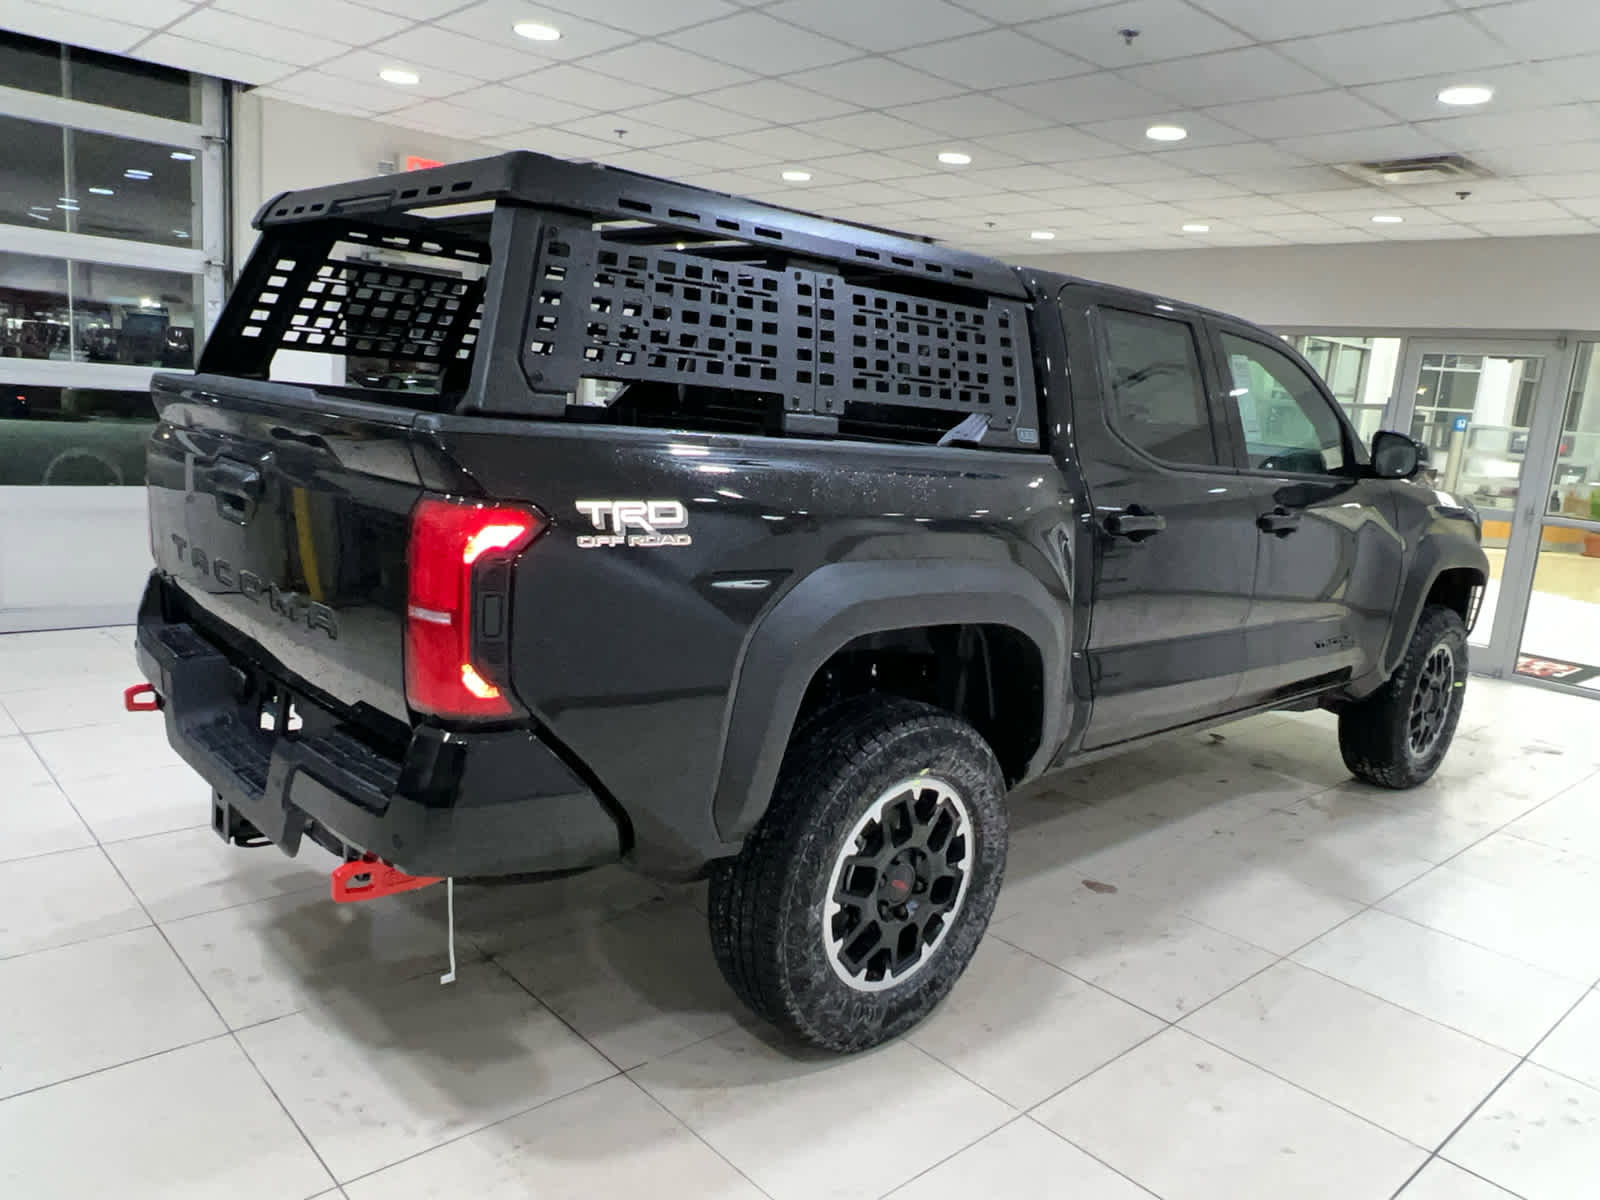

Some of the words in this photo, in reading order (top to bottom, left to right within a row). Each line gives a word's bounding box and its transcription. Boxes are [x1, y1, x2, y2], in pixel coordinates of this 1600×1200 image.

[575, 499, 688, 536] TRD
[576, 535, 626, 548] OFF
[627, 535, 692, 548] ROAD
[171, 533, 338, 640] TACOMA
